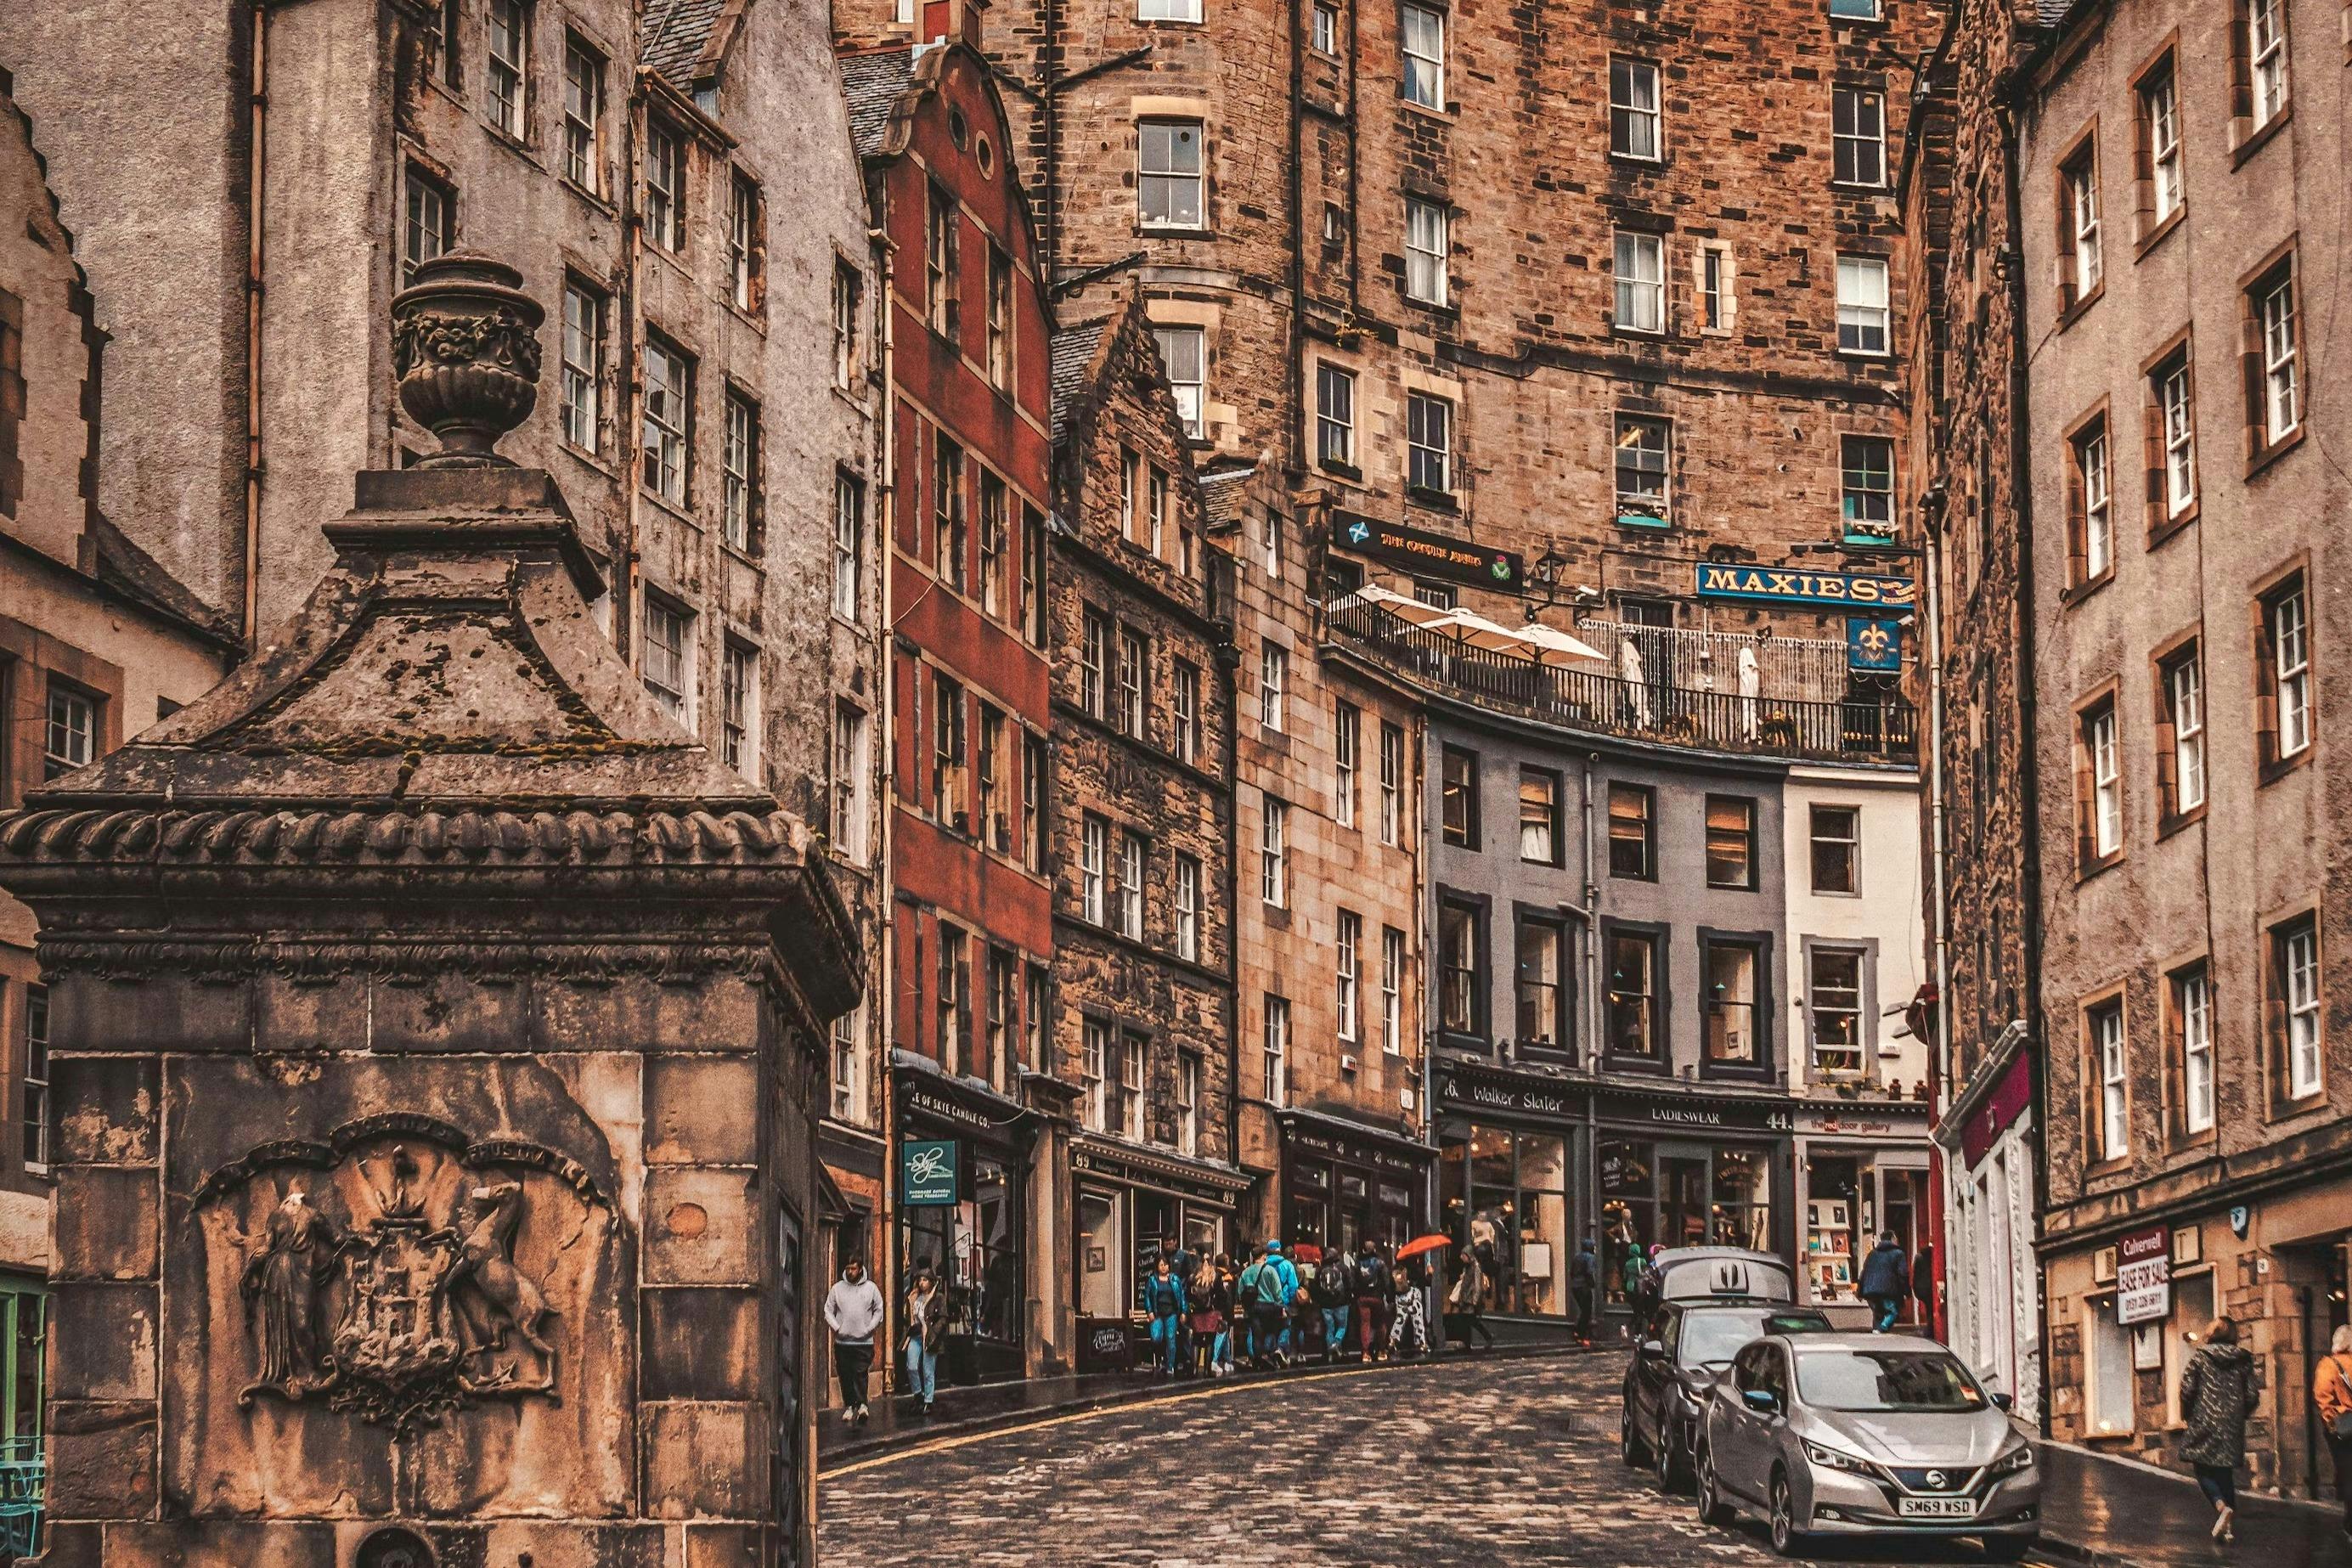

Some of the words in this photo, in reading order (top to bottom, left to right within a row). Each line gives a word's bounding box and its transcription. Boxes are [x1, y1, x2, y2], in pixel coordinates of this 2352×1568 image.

[1704, 569, 1879, 601] MAXIES
[1474, 1086, 1514, 1106] Walker
[1523, 1092, 1563, 1112] Slater
[951, 1105, 977, 1124] CANDLE
[1652, 1108, 1720, 1125] LADIESWEAR
[1076, 1153, 1090, 1169] 89
[2124, 1231, 2162, 1256] Culverwell
